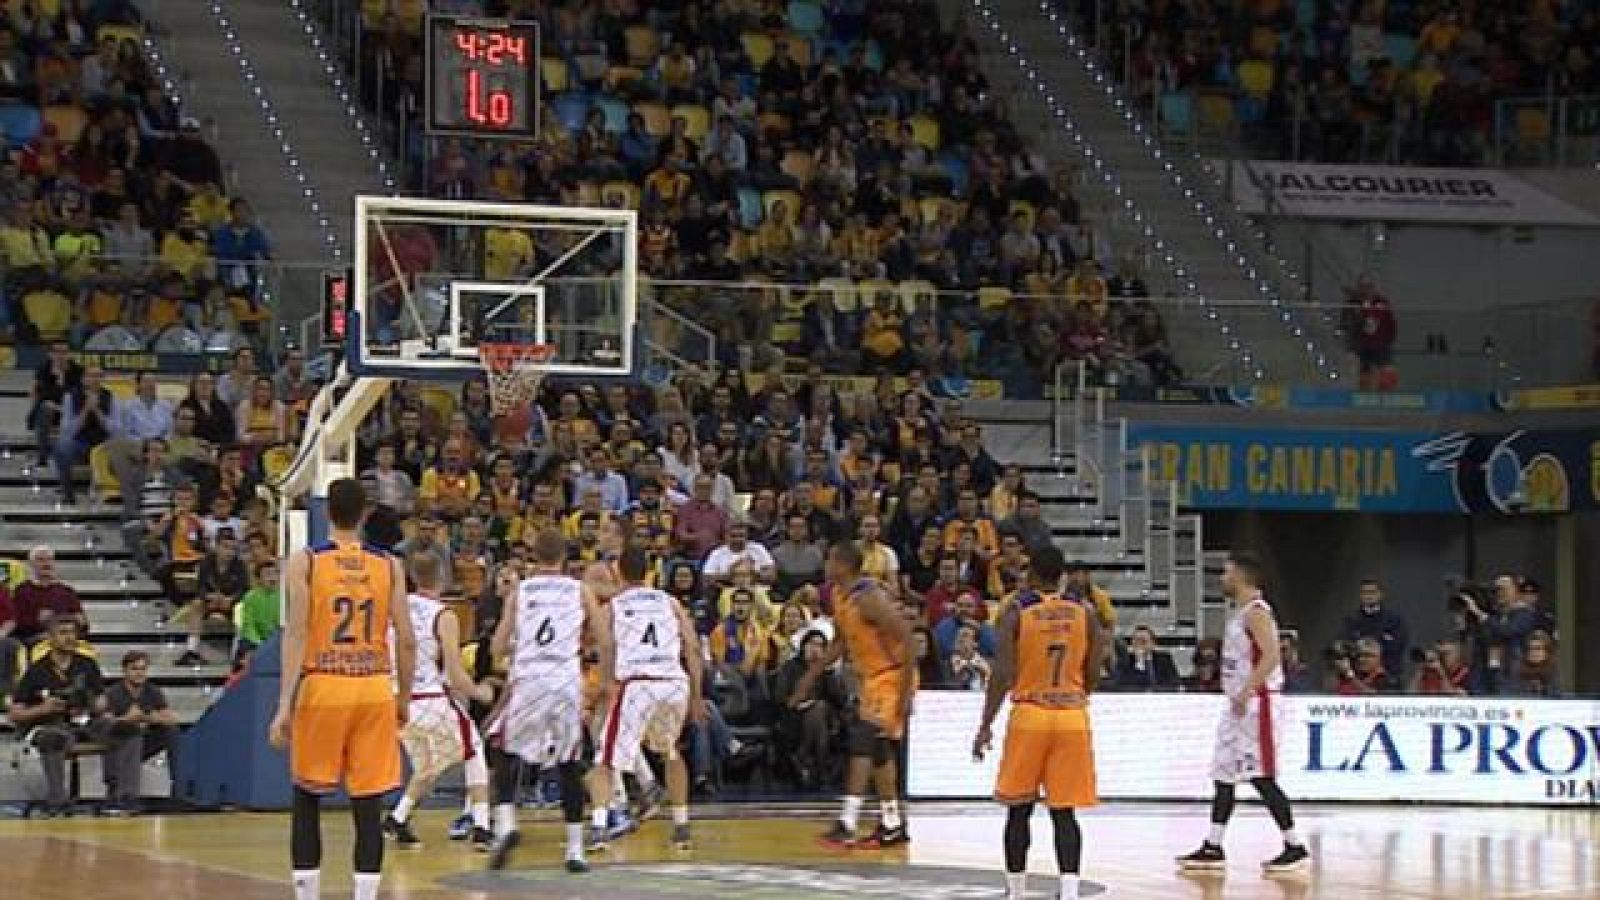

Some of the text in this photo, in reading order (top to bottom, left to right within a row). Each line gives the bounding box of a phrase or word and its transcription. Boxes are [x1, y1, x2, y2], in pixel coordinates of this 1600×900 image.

[456, 33, 525, 64] 4:24
[1247, 442, 1398, 496] CANARIA
[332, 596, 374, 645] 21
[535, 616, 556, 646] 6
[640, 622, 658, 648] 4
[1046, 643, 1066, 688] 7
[1301, 721, 1407, 771] LA
